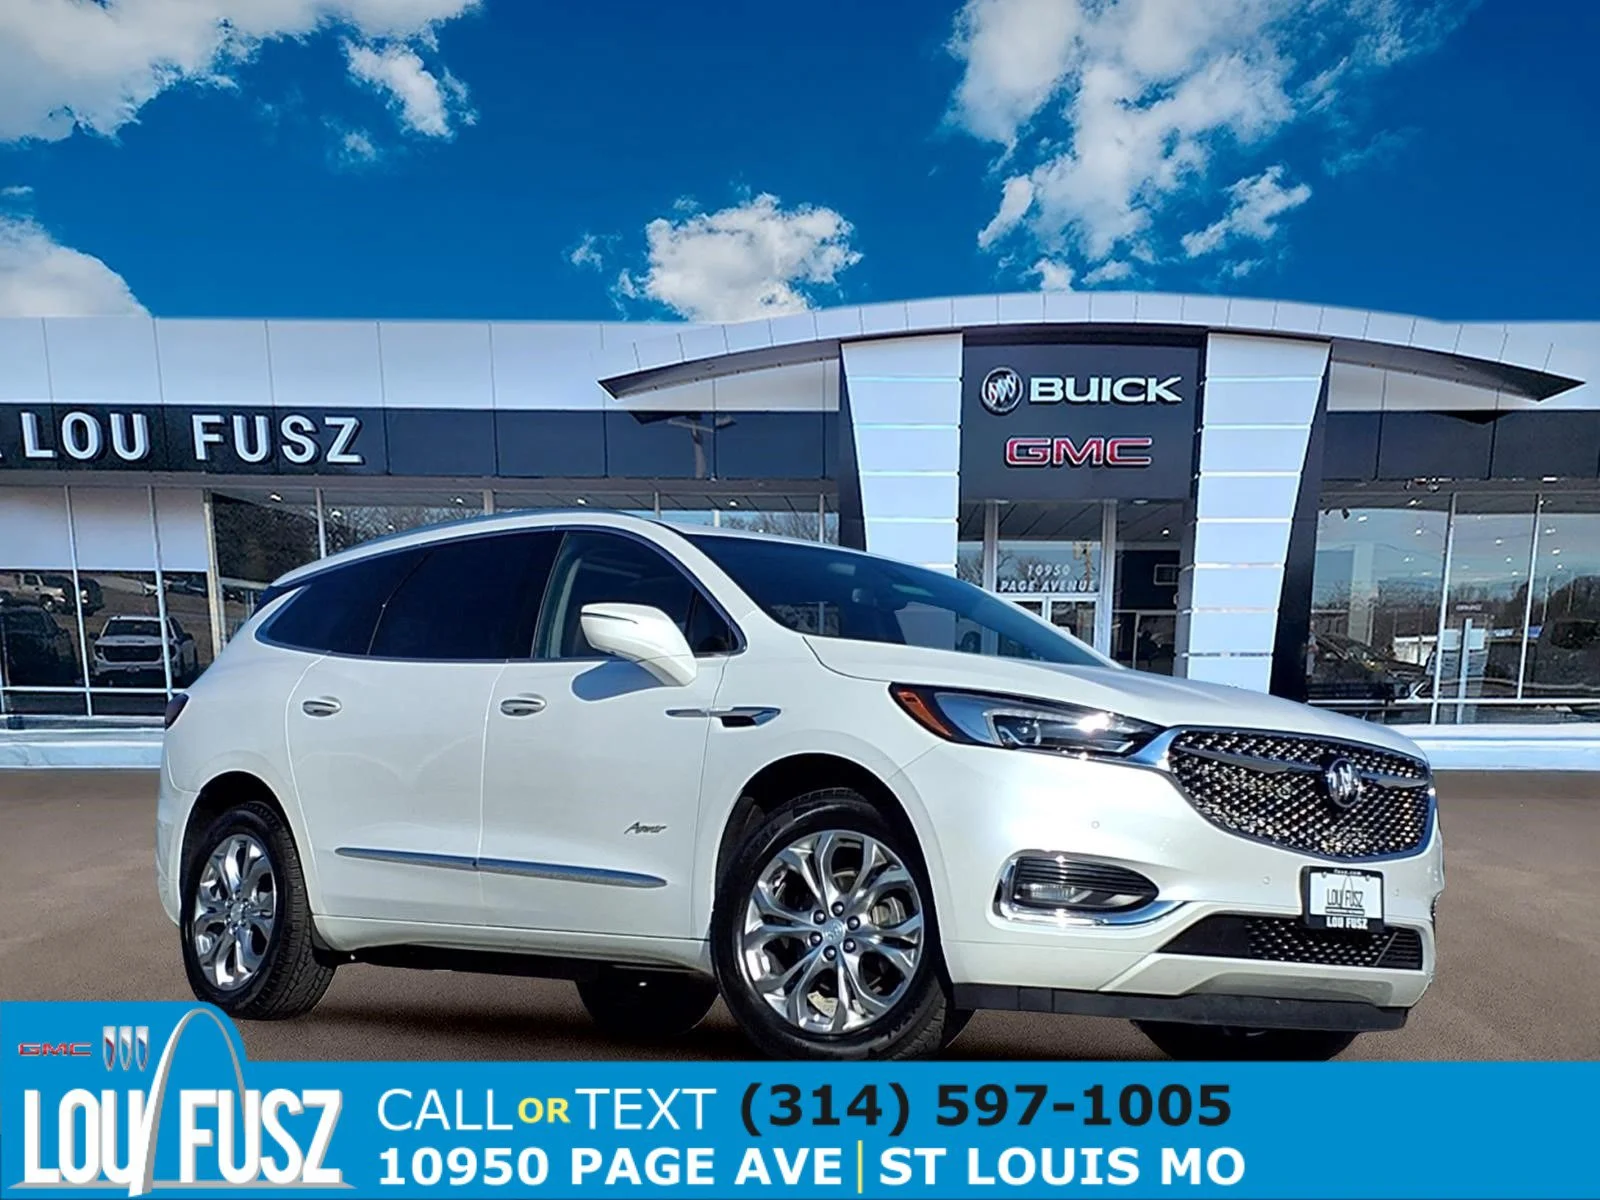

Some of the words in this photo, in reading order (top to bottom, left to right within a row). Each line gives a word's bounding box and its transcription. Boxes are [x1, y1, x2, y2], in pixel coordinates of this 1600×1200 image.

[1030, 376, 1183, 402] BUICK
[20, 411, 151, 462] LOU
[192, 413, 364, 464] FUSZ
[1005, 437, 1153, 466] GMC
[1027, 564, 1071, 577] 10950
[1000, 580, 1037, 592] PAGE
[1040, 580, 1097, 592] AVENUE
[1327, 888, 1343, 907] LOU
[1326, 916, 1344, 928] LOU
[1345, 917, 1369, 930] FUSZ
